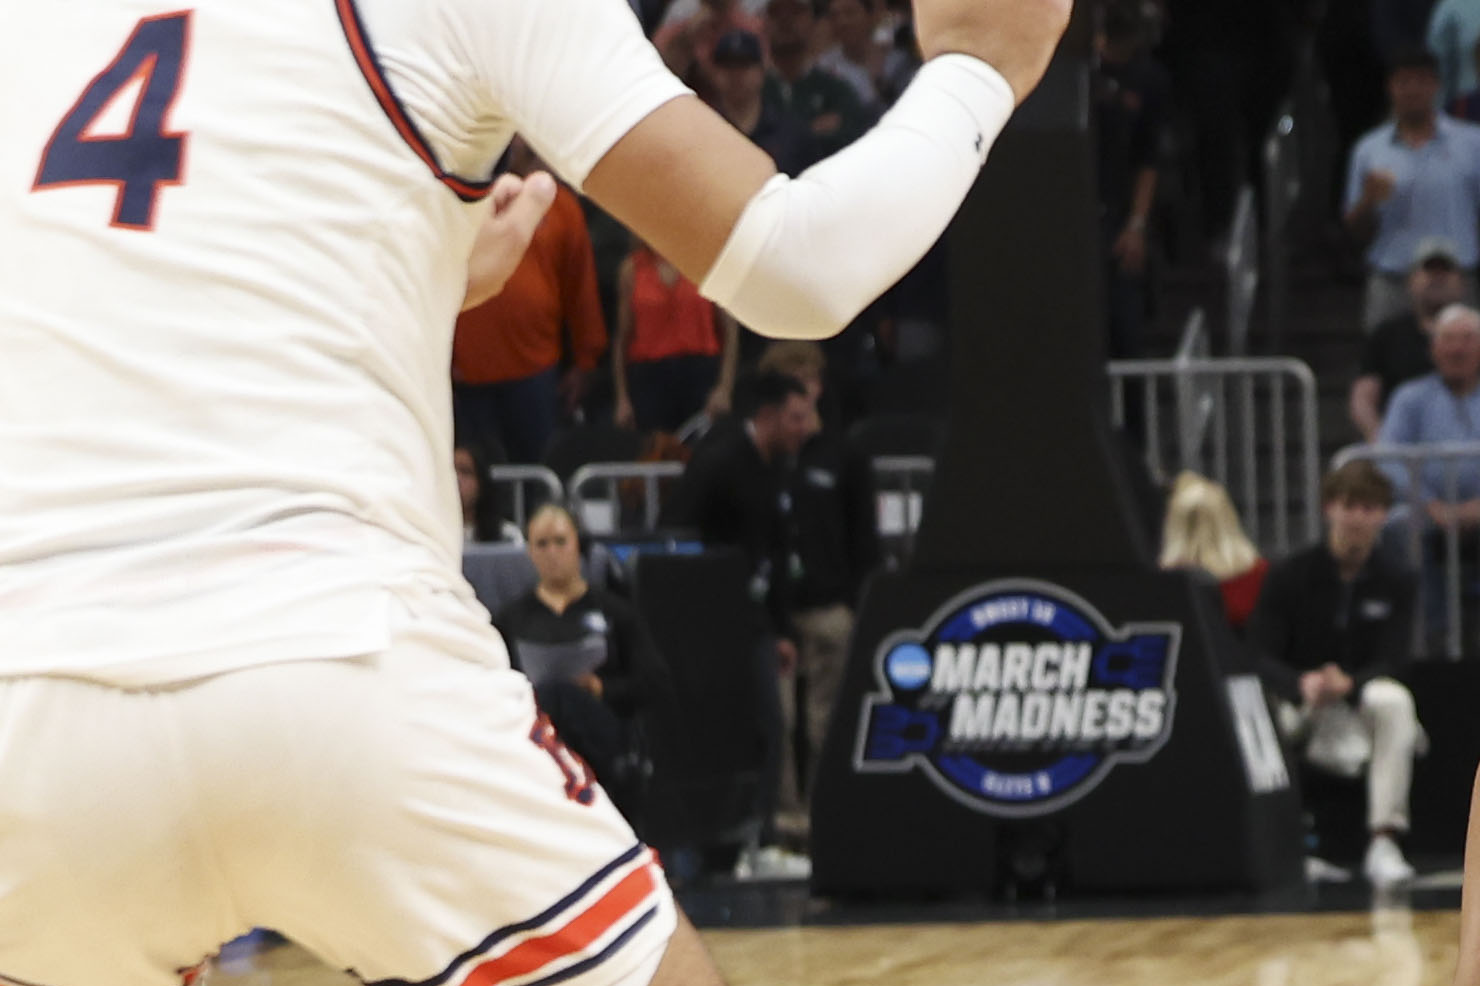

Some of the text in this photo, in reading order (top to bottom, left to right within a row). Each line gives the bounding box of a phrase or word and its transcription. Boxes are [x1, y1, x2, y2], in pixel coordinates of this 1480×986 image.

[30, 8, 193, 232] 4
[930, 641, 1093, 691] MARCH
[949, 689, 1167, 741] MADNESS
